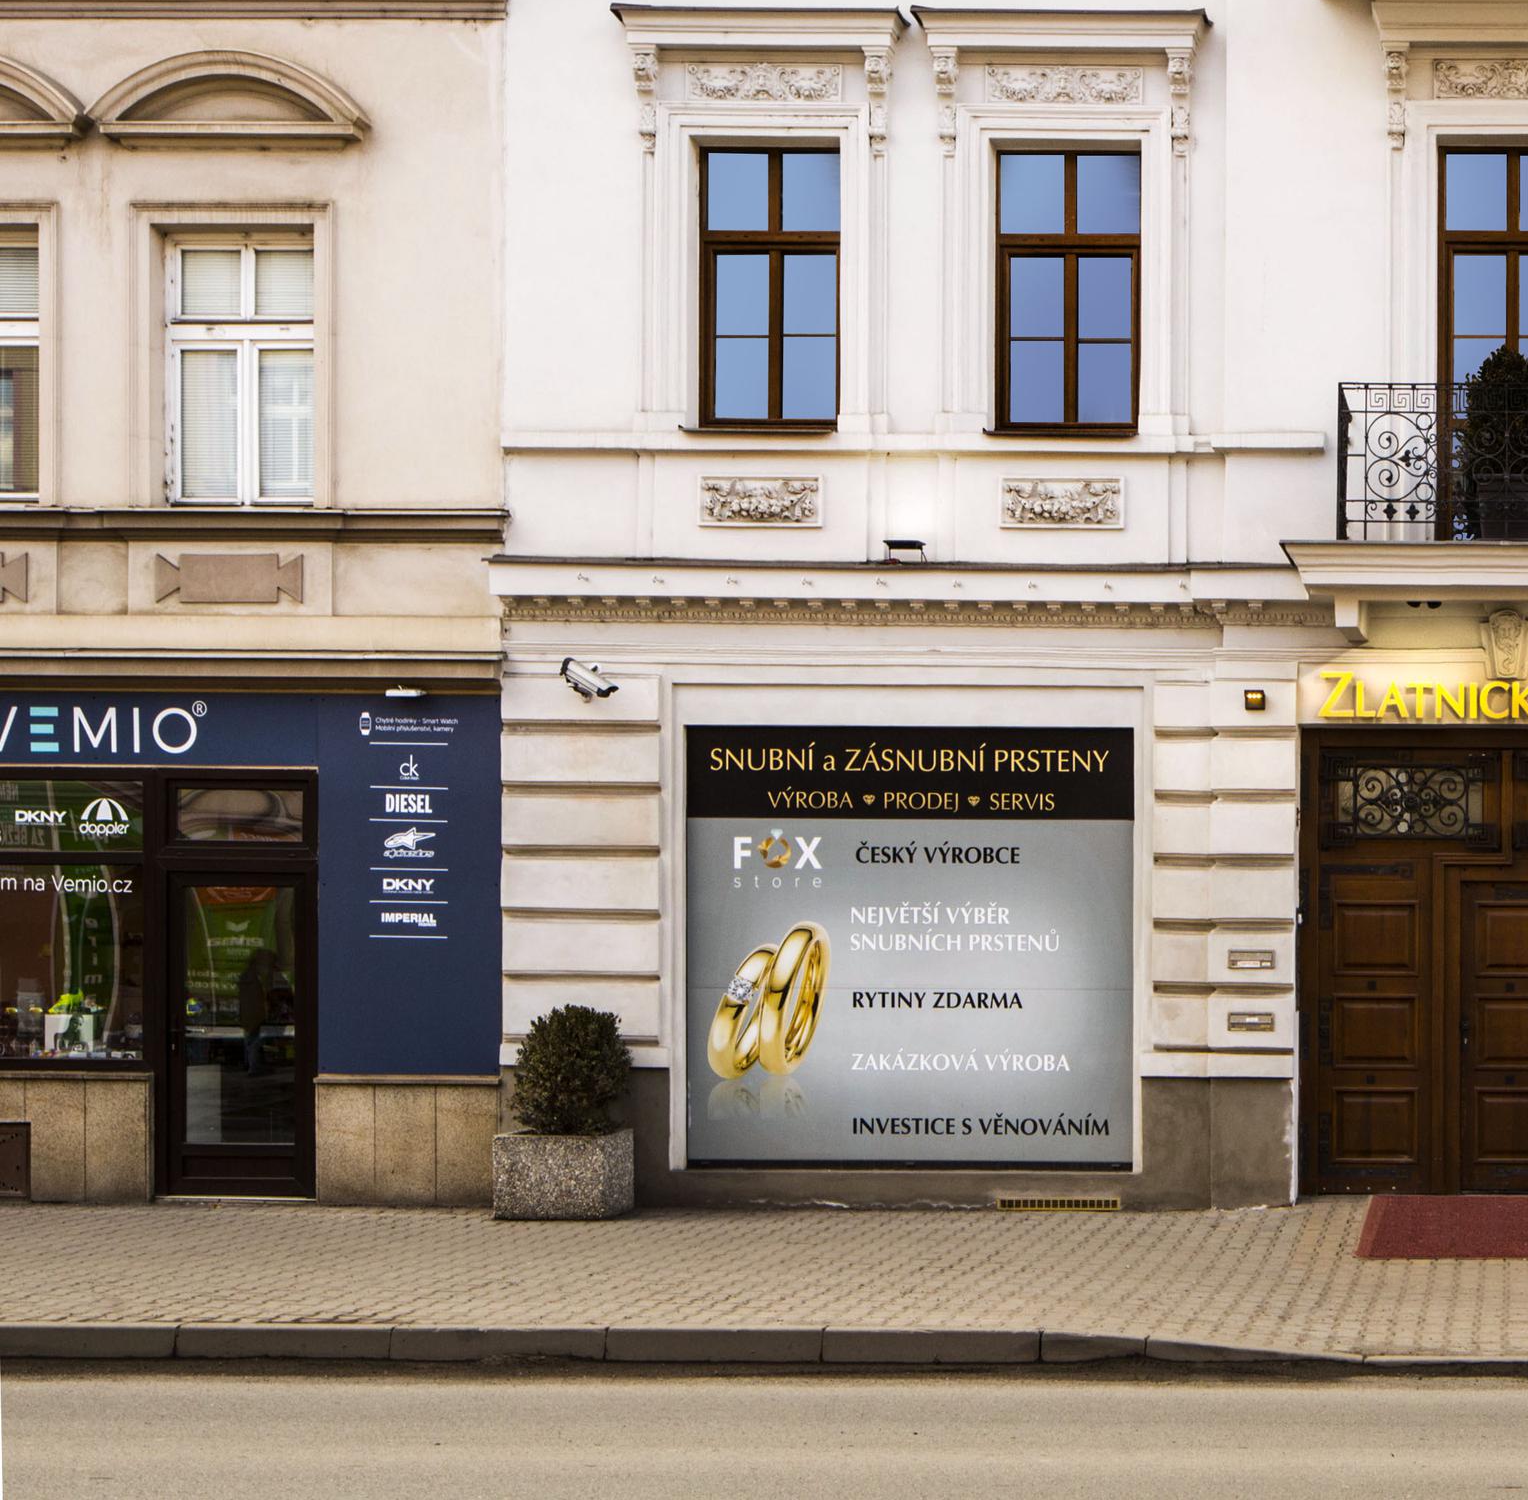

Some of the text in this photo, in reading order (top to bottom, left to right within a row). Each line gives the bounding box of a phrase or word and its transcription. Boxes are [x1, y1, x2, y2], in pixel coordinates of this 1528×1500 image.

[422, 717, 439, 725] Smart
[440, 717, 459, 725] Watch
[400, 754, 420, 777] ck
[710, 741, 1110, 773] SNUBNÍ a ZÁSNUBNÍ PRSTENY
[385, 793, 433, 814] DIESEL
[767, 786, 1056, 812] VÝROBA PRODEJ SERVIS
[15, 810, 67, 824] DKNY
[79, 821, 130, 837] doppler
[855, 840, 1020, 865] ČESKÝ VÝROBCE
[23, 877, 46, 892] na
[51, 874, 133, 893] Vemio.cz
[382, 878, 435, 891] DKNY
[733, 875, 822, 889] store
[381, 912, 437, 924] IMPERIAL
[850, 902, 1010, 927] NEJVĚTŠÍ VÝBĚR
[850, 928, 1060, 952] SNUBNÍCH PRSTENŮ
[852, 991, 1023, 1009] RYTINY ZDARMA
[851, 1047, 1071, 1072] ZAKÁZKOVÁ VÝROBA
[852, 1112, 1110, 1136] INVESTICE S VĚNOVÁNÍM
